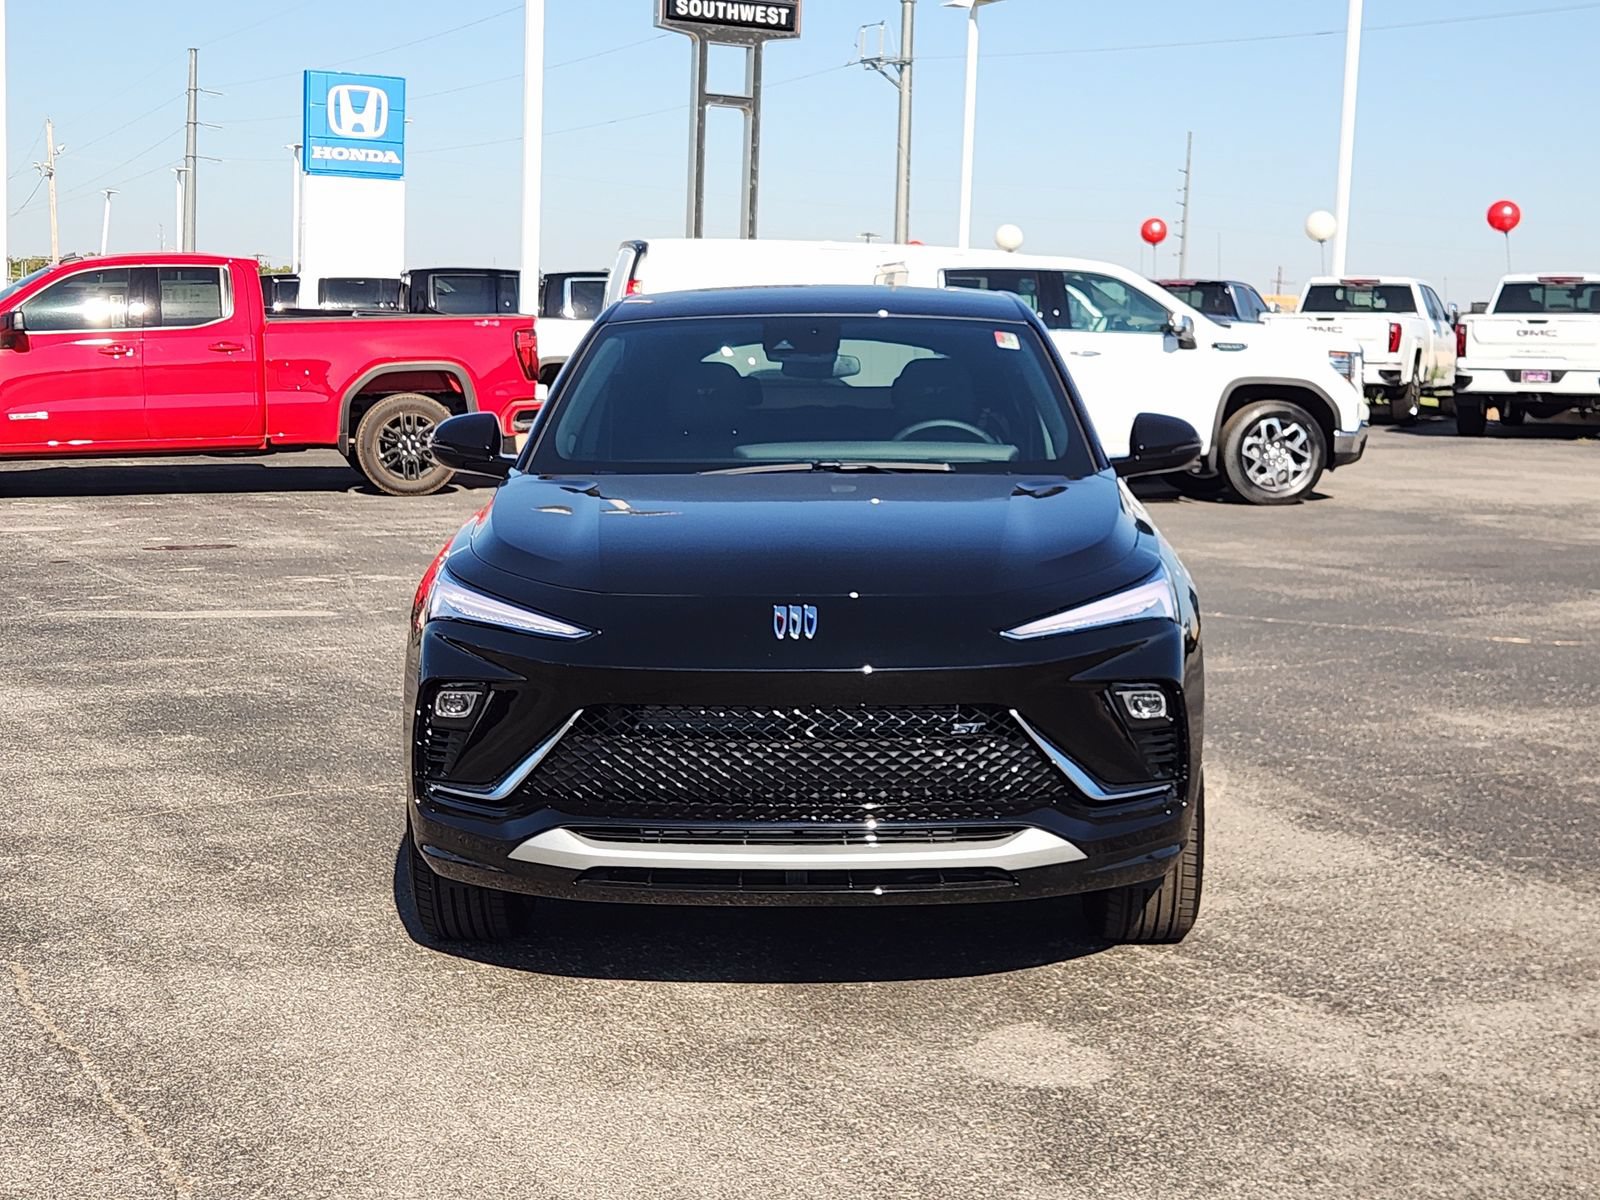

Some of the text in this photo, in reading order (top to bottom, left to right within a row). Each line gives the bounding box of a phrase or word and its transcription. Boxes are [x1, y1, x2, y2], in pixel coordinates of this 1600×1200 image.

[675, 0, 789, 25] SOUTHWEST
[311, 145, 401, 164] HONDA
[1516, 329, 1557, 337] GMC
[950, 722, 986, 735] ST
